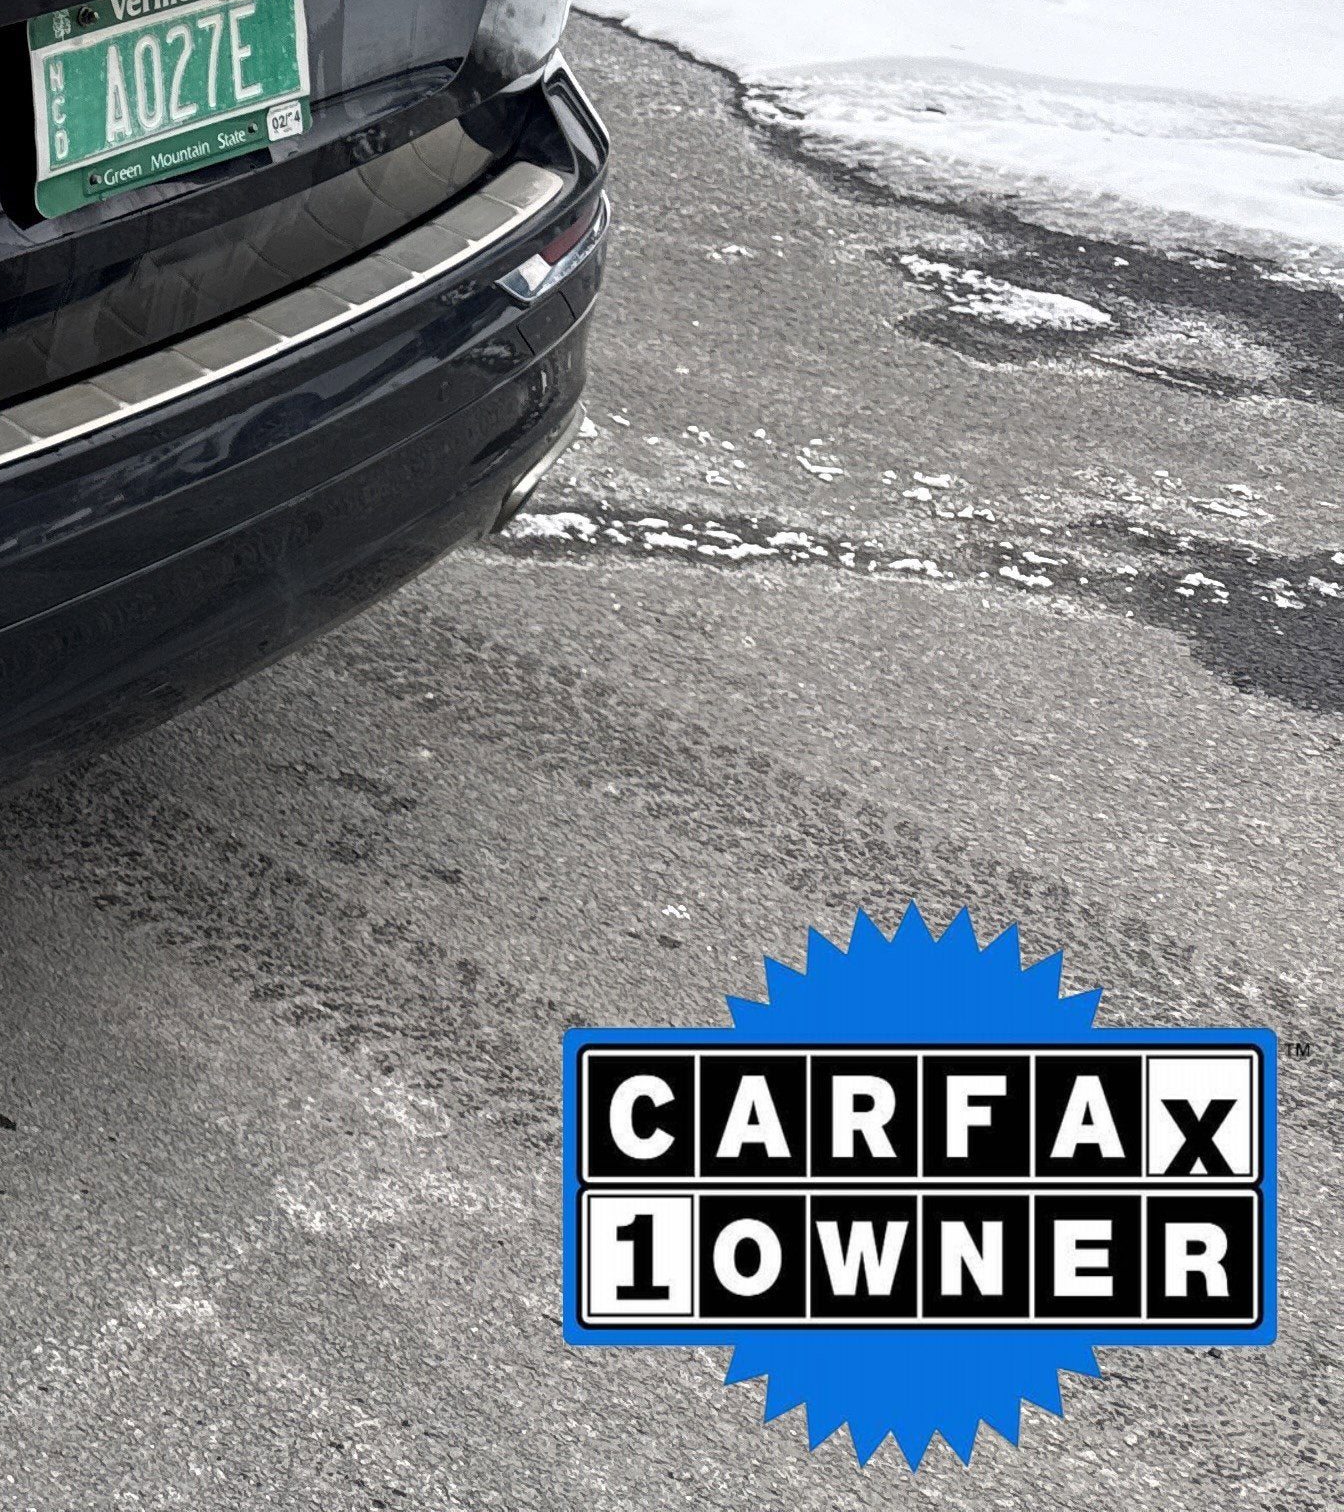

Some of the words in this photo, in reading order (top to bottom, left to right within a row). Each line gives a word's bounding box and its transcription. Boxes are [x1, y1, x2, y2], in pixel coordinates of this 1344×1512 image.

[105, 1, 263, 143] A027E
[103, 163, 143, 187] Green
[150, 141, 210, 172] Mountain
[217, 129, 246, 151] State
